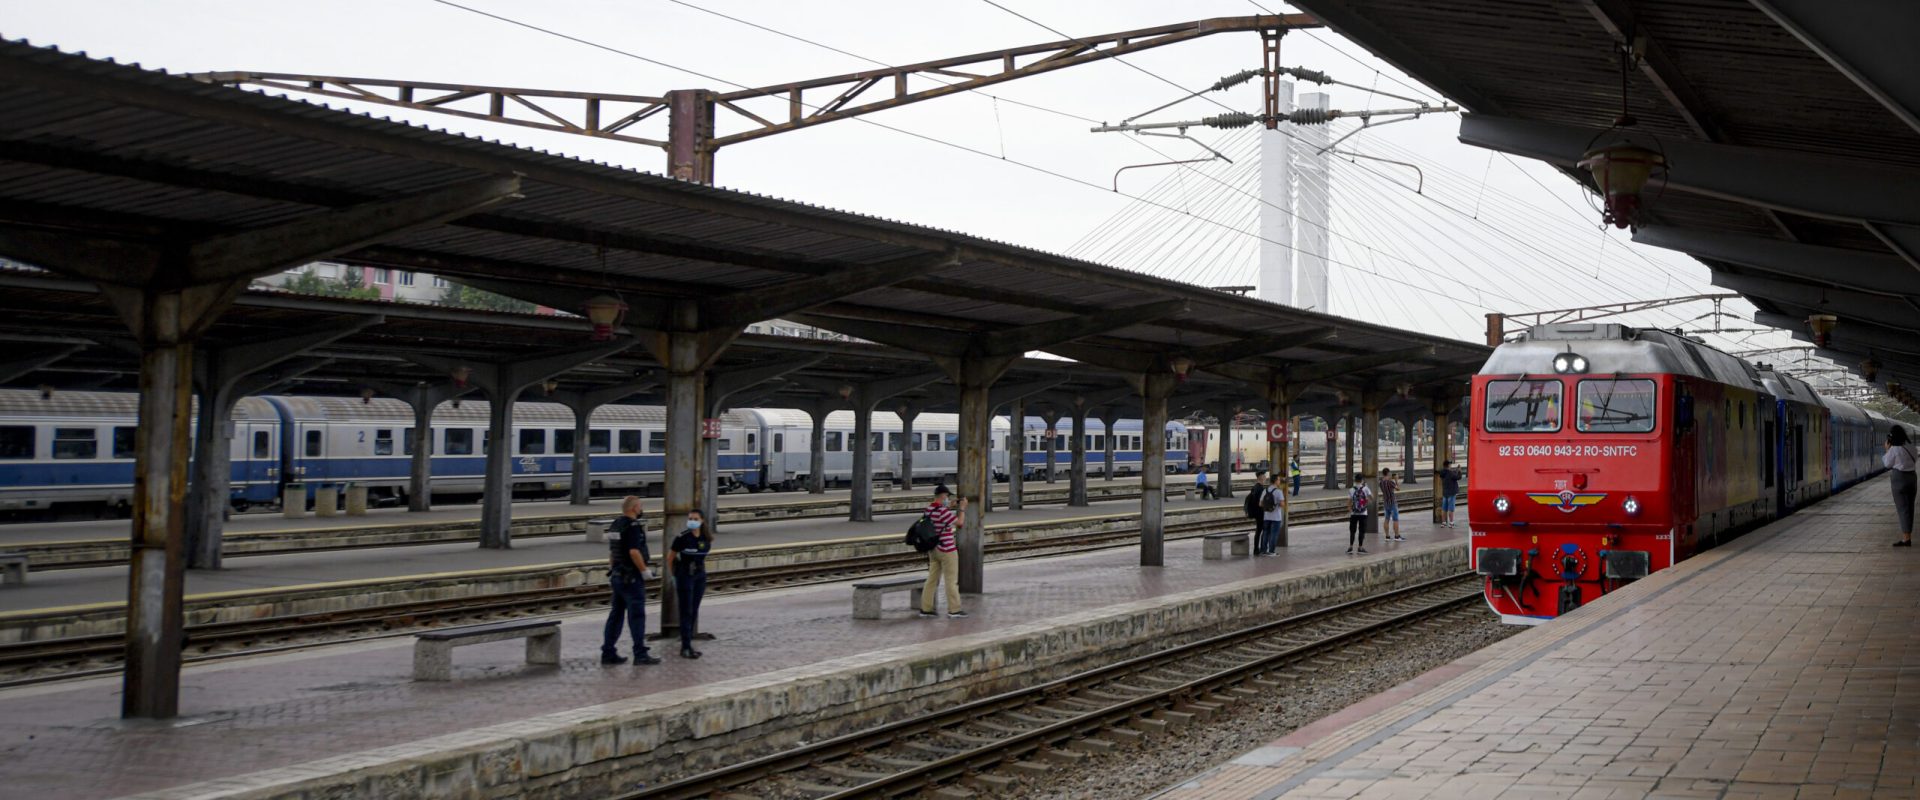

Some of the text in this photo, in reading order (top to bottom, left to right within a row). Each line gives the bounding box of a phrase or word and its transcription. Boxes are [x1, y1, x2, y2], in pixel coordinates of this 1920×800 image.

[358, 430, 366, 443] 2
[1271, 423, 1283, 439] C
[1328, 431, 1334, 439] D
[1499, 446, 1636, 456] 92 53 0640 943-2 RO-SNTFC
